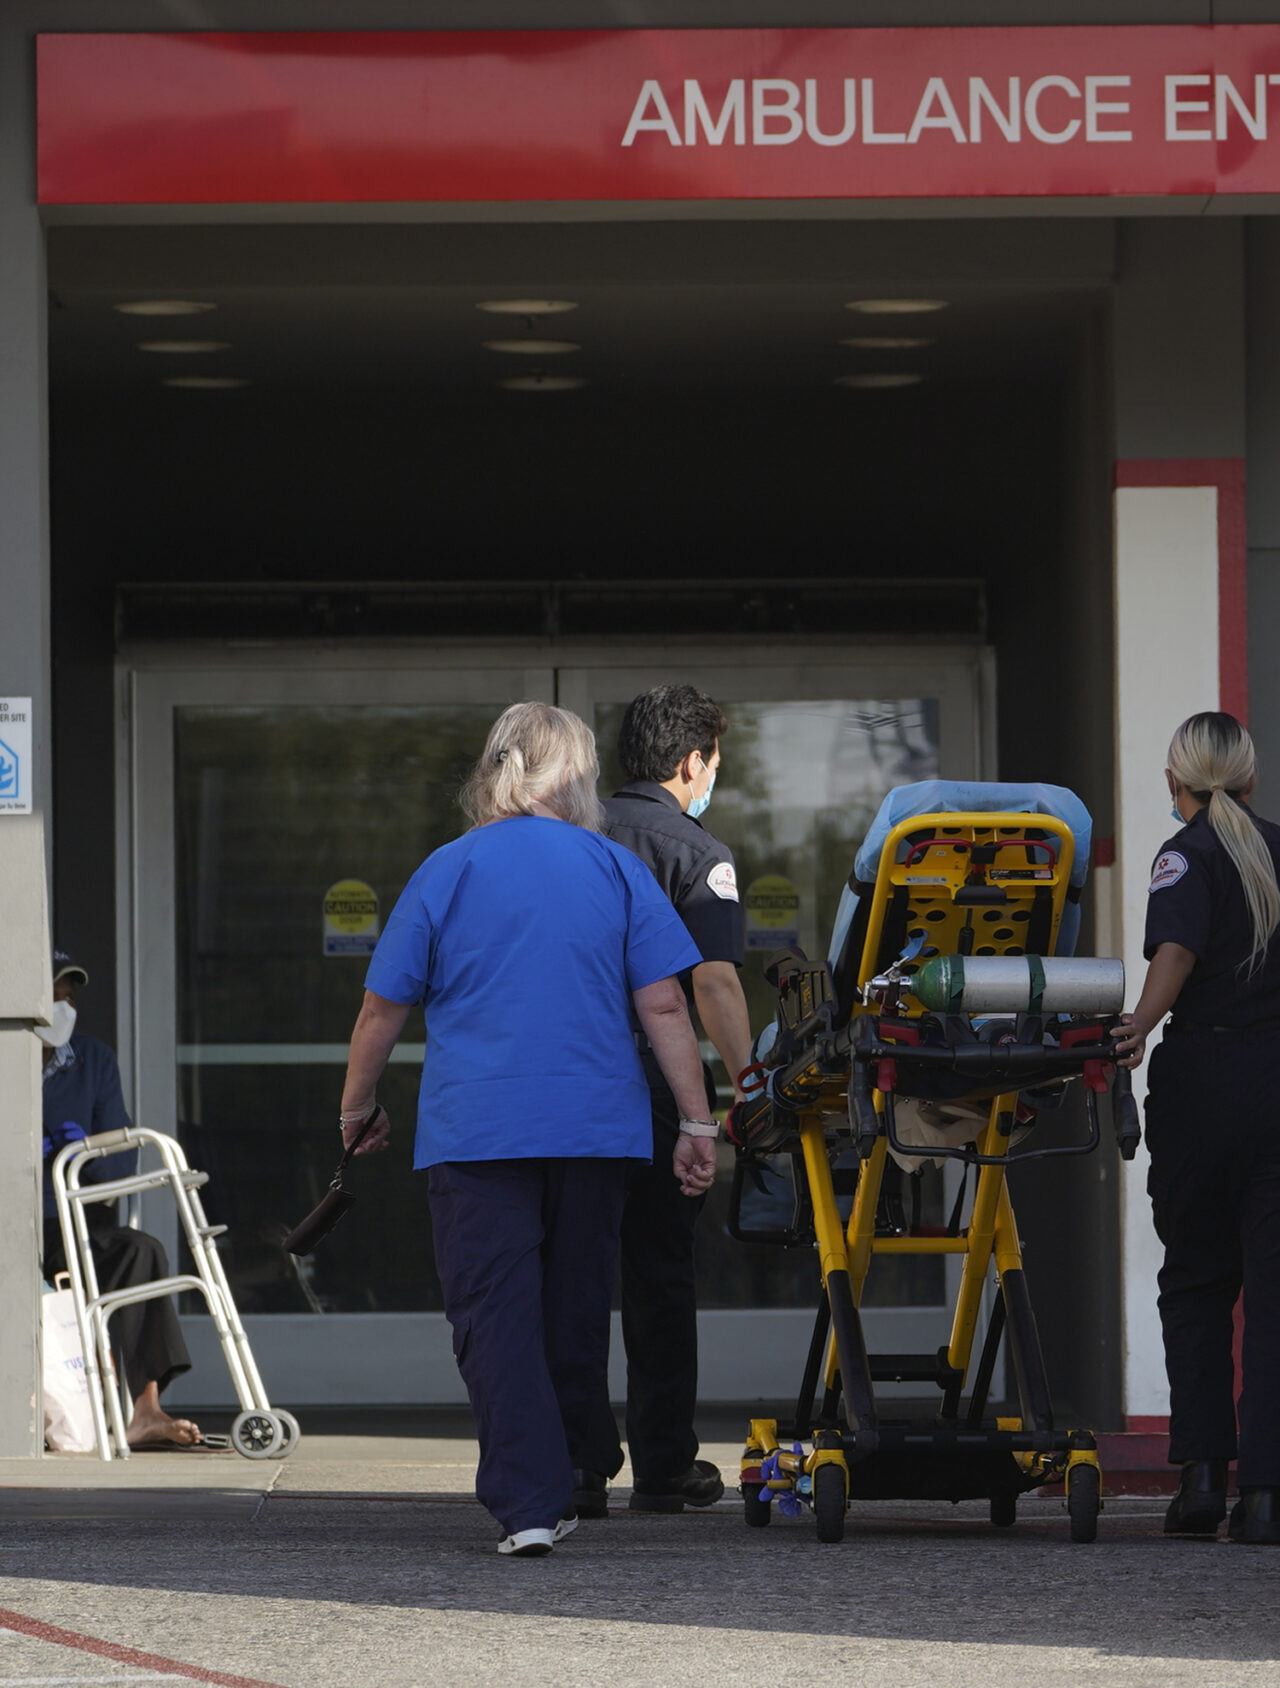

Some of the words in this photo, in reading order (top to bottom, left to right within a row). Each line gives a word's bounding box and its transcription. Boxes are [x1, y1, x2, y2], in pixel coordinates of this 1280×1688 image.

[622, 76, 1132, 146] AMBULANCE
[11, 713, 26, 722] SITE
[748, 896, 797, 907] CAUTION
[327, 903, 375, 913] CAUTION
